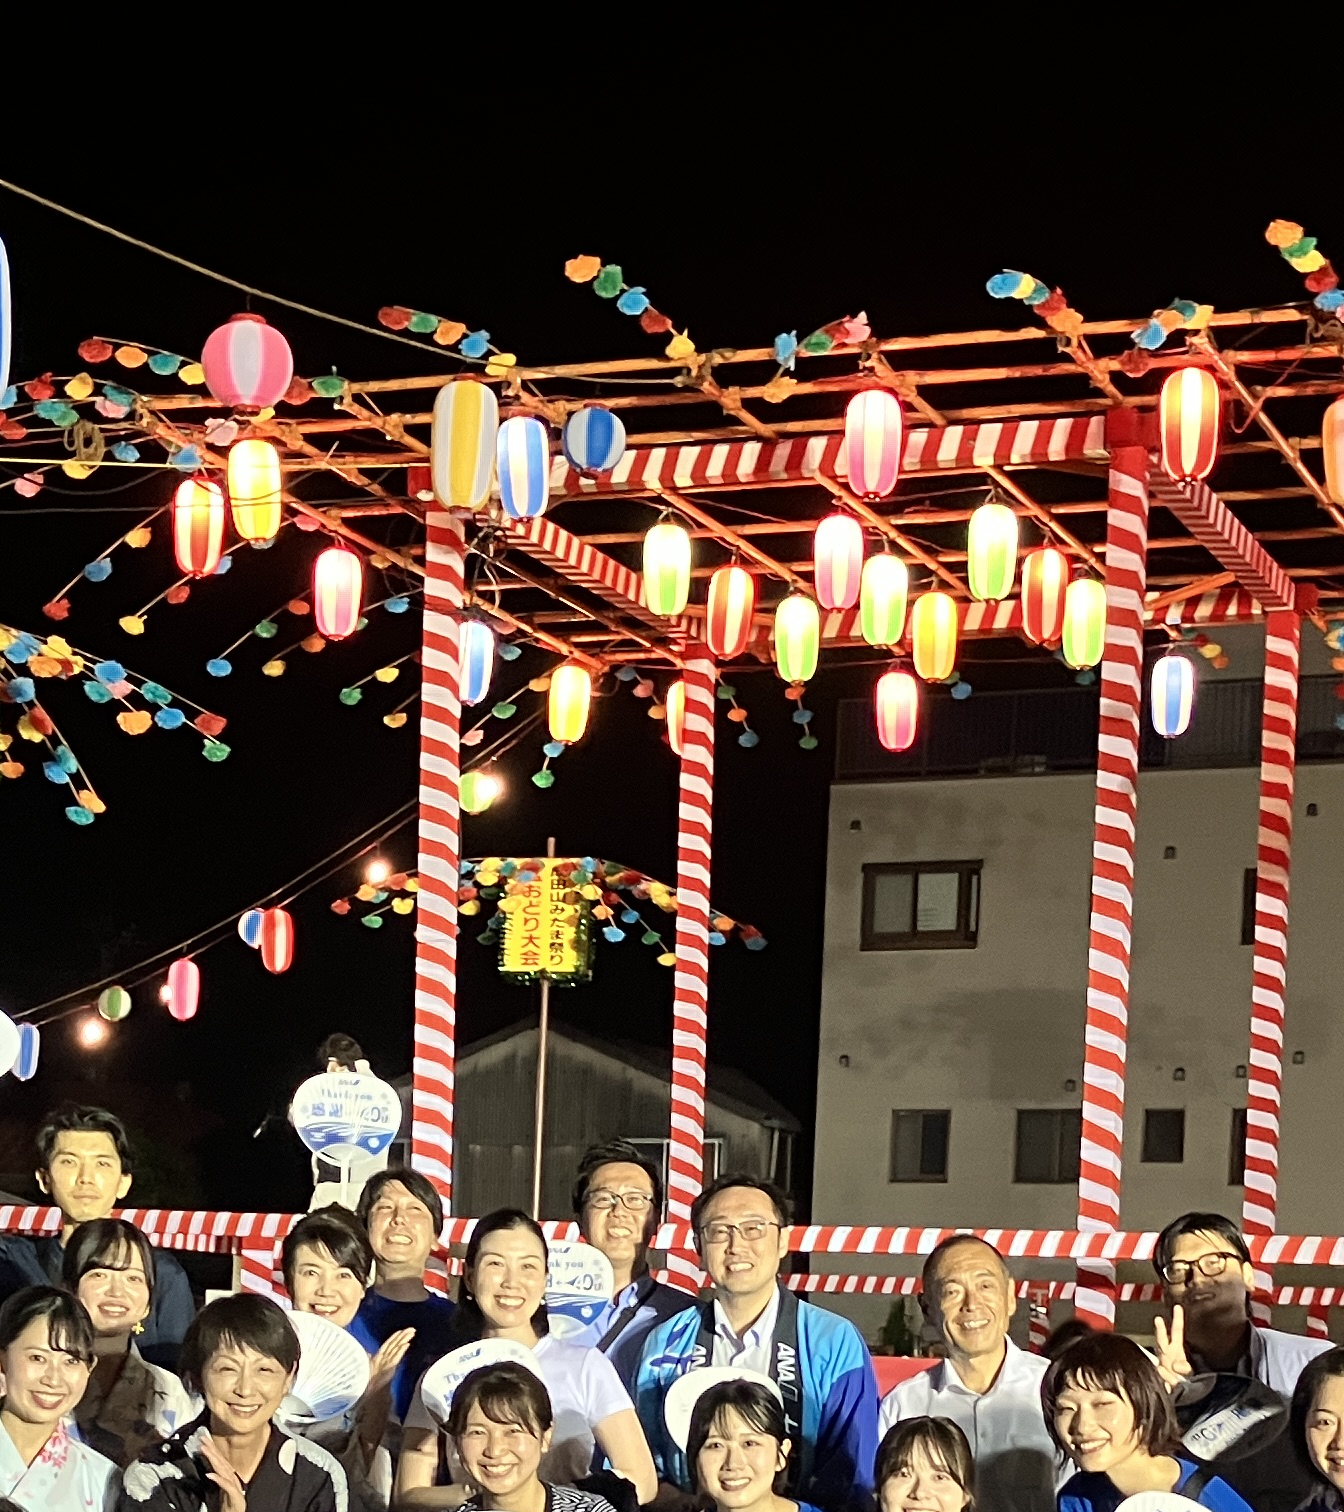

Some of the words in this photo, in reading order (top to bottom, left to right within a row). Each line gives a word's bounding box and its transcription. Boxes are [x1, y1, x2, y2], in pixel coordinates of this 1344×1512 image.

[520, 876, 543, 967] おどり大会
[777, 1342, 796, 1382] ANA
